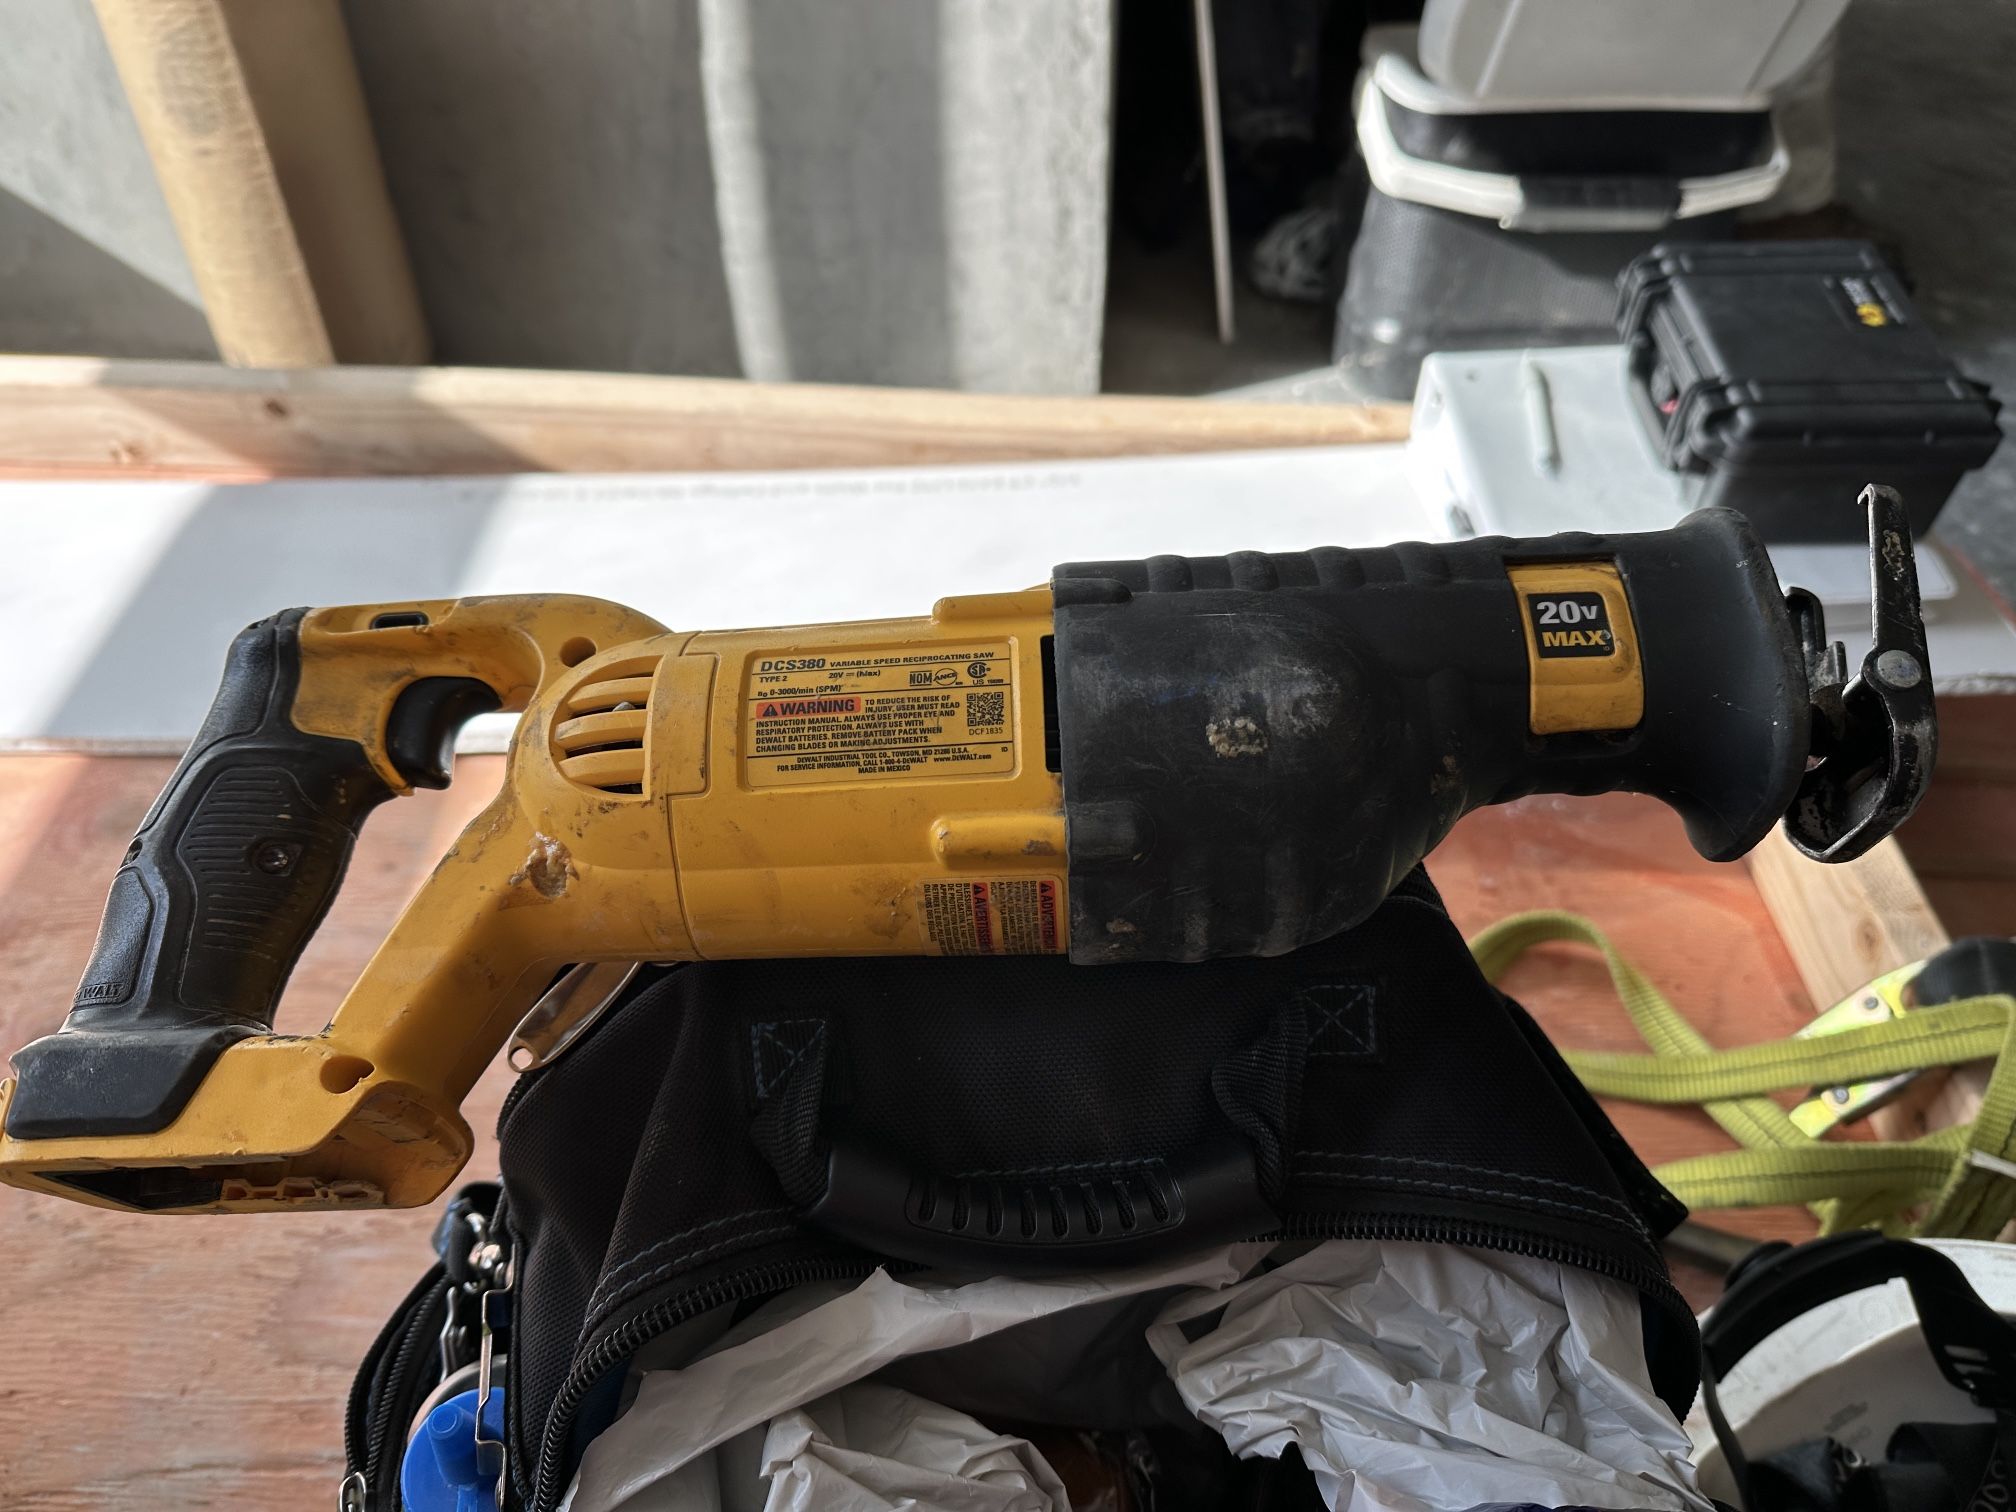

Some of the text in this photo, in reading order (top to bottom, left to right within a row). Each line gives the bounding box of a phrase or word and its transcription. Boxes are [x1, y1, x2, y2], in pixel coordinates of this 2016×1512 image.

[760, 658, 826, 672] DCS380
[830, 658, 871, 668] VARIABLE
[903, 653, 971, 662] RECIPROCATING
[909, 672, 958, 684] NOM ANCE
[769, 687, 814, 696] 0-3000/min
[816, 684, 842, 694] (SPM)
[780, 699, 855, 716] WARNING
[756, 718, 806, 728] INSTRUCTION
[844, 714, 875, 722] ALWAYS
[756, 727, 806, 736] RESPIRATORY
[756, 735, 786, 744] DEWALT
[831, 731, 861, 740] REMOVE
[863, 730, 896, 738] BATTERY
[920, 726, 942, 734] WHEN
[756, 744, 796, 753] CHANGING
[798, 742, 826, 750] BLADES
[840, 739, 871, 747] MAKING
[790, 762, 816, 771] SERVICE
[934, 754, 992, 762] www.DEWALT.com
[824, 754, 860, 762] INDUSTRIAL
[924, 884, 932, 893] OU
